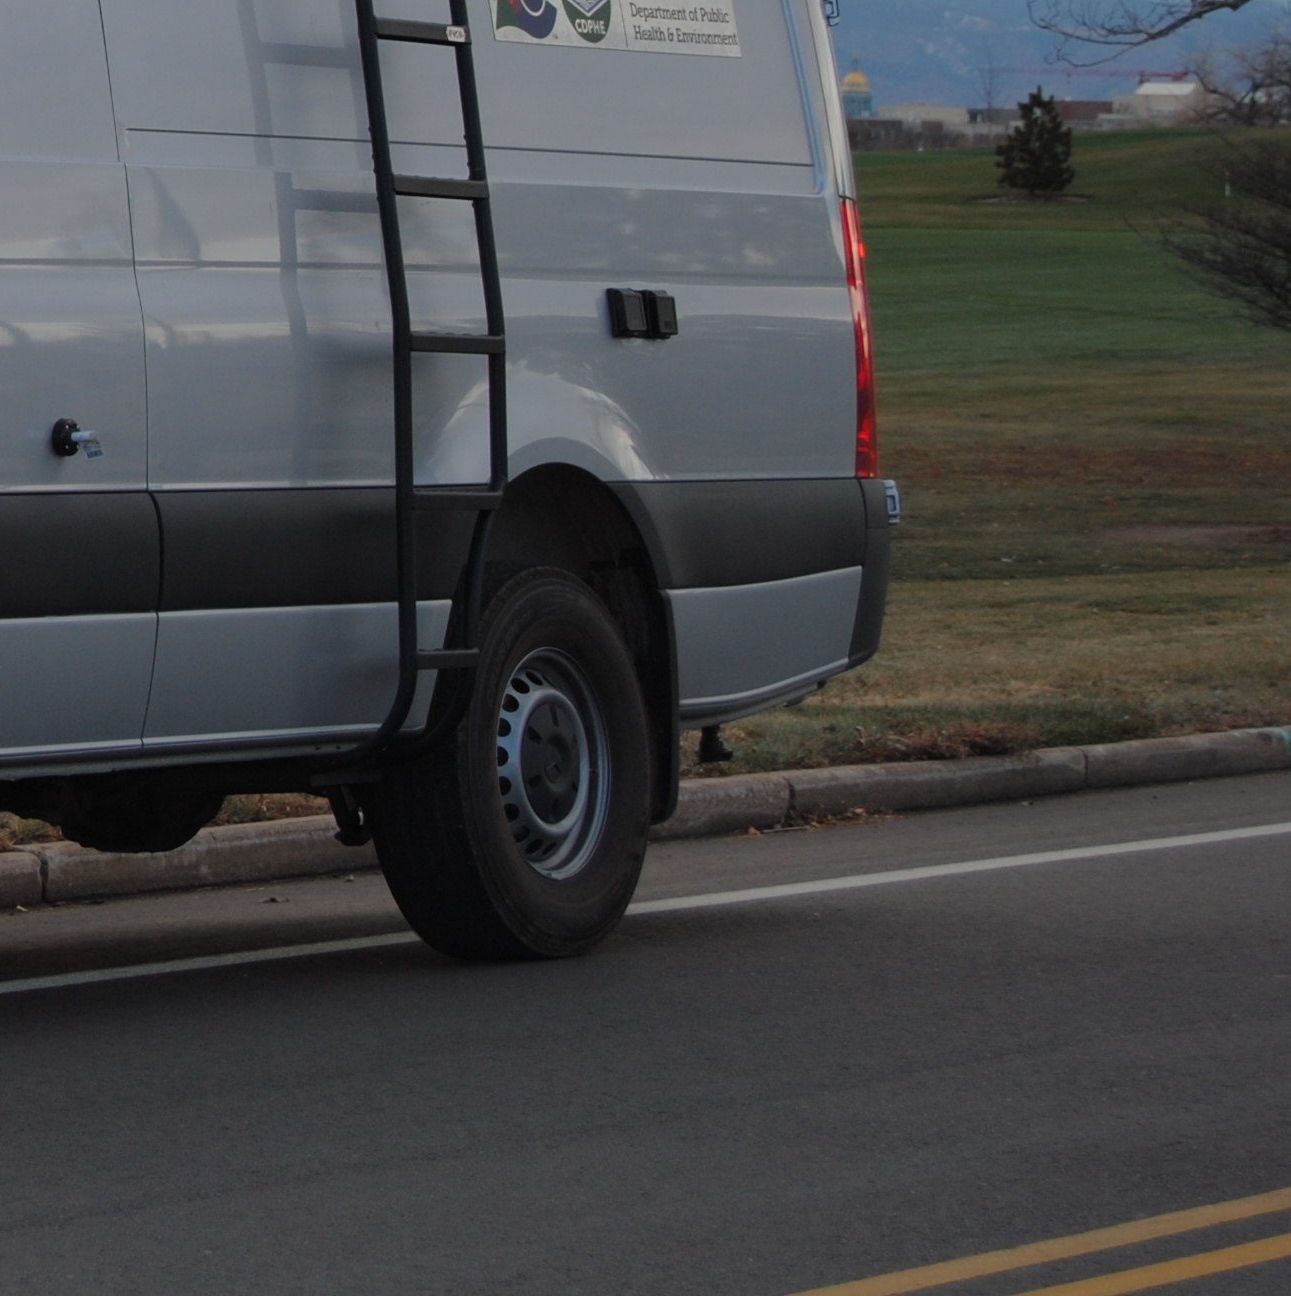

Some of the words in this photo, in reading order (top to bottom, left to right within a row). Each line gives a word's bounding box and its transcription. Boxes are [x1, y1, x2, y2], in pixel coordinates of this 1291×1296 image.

[629, 2, 687, 22] Department
[688, 7, 699, 22] of
[699, 7, 730, 23] Public
[574, 18, 606, 35] CDPHE
[633, 25, 666, 42] Health
[666, 27, 674, 42] &
[675, 28, 738, 46] Environment
